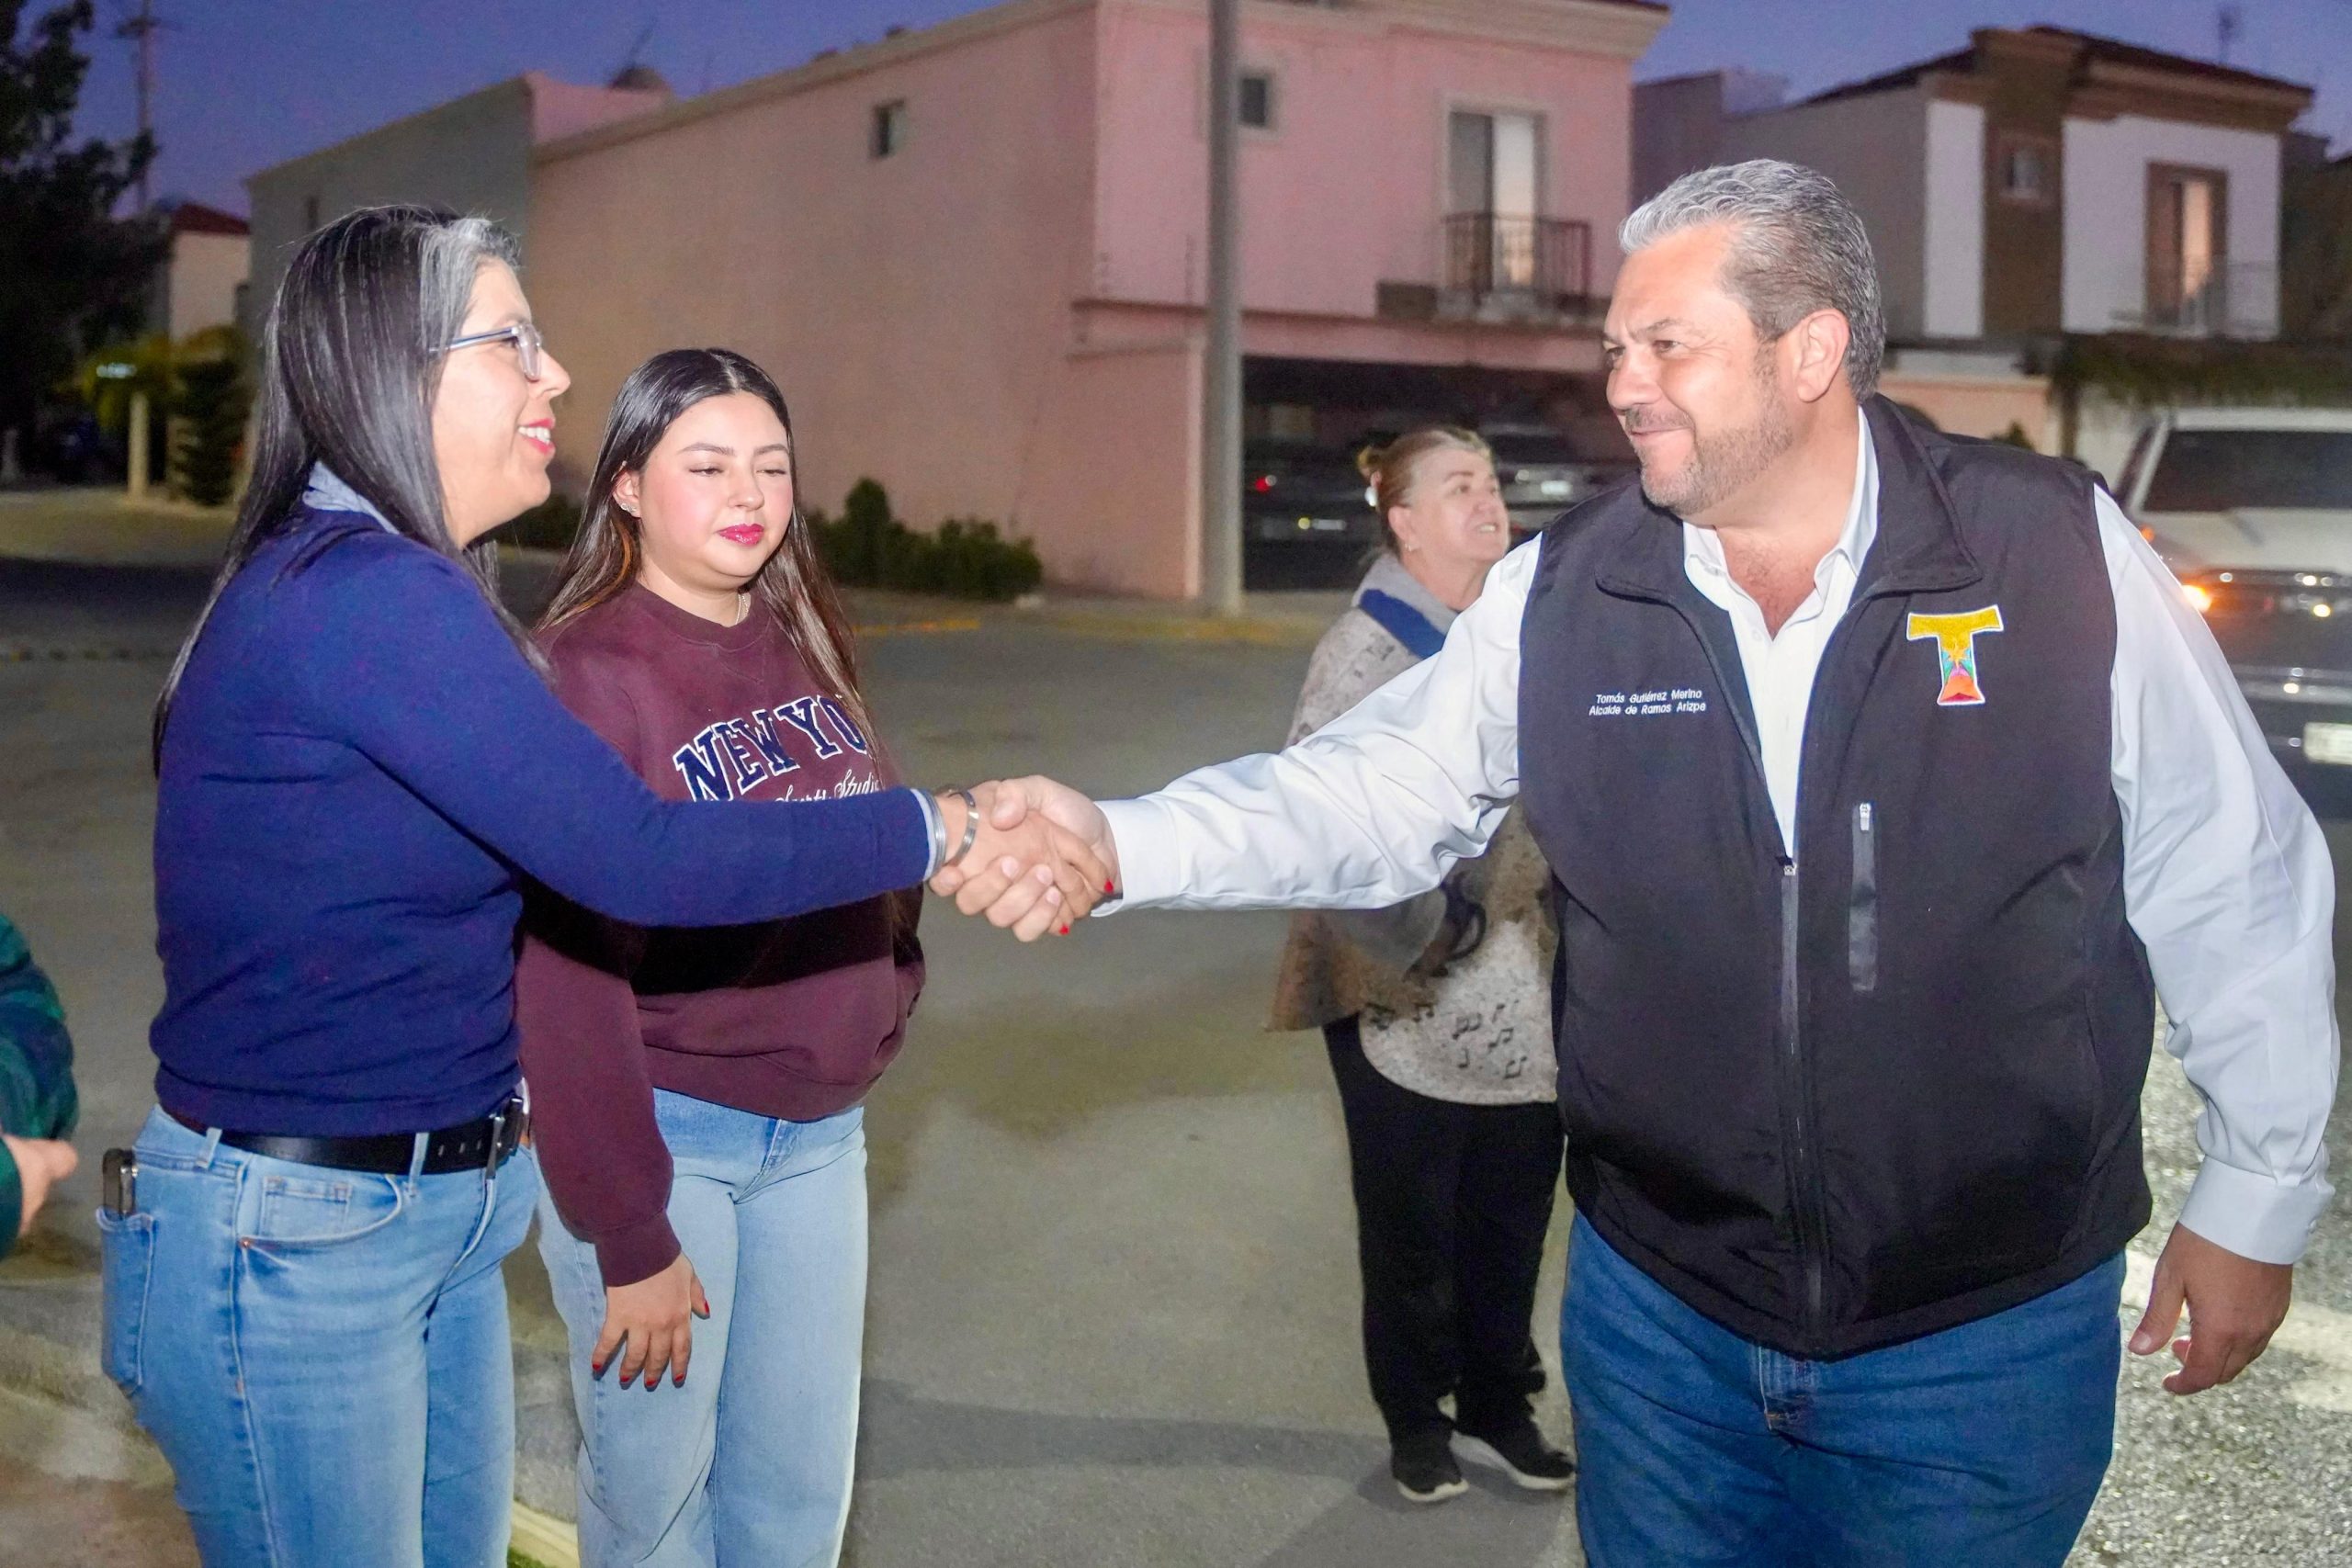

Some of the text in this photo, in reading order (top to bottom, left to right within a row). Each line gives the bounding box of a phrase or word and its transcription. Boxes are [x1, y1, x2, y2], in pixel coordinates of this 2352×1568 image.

[1906, 604, 2004, 706] T
[1589, 701, 1706, 716] Alcalde de Ramos Arizpe
[1596, 689, 1702, 704] Tomás Gutiérrez Merino
[673, 695, 868, 803] NEW YO
